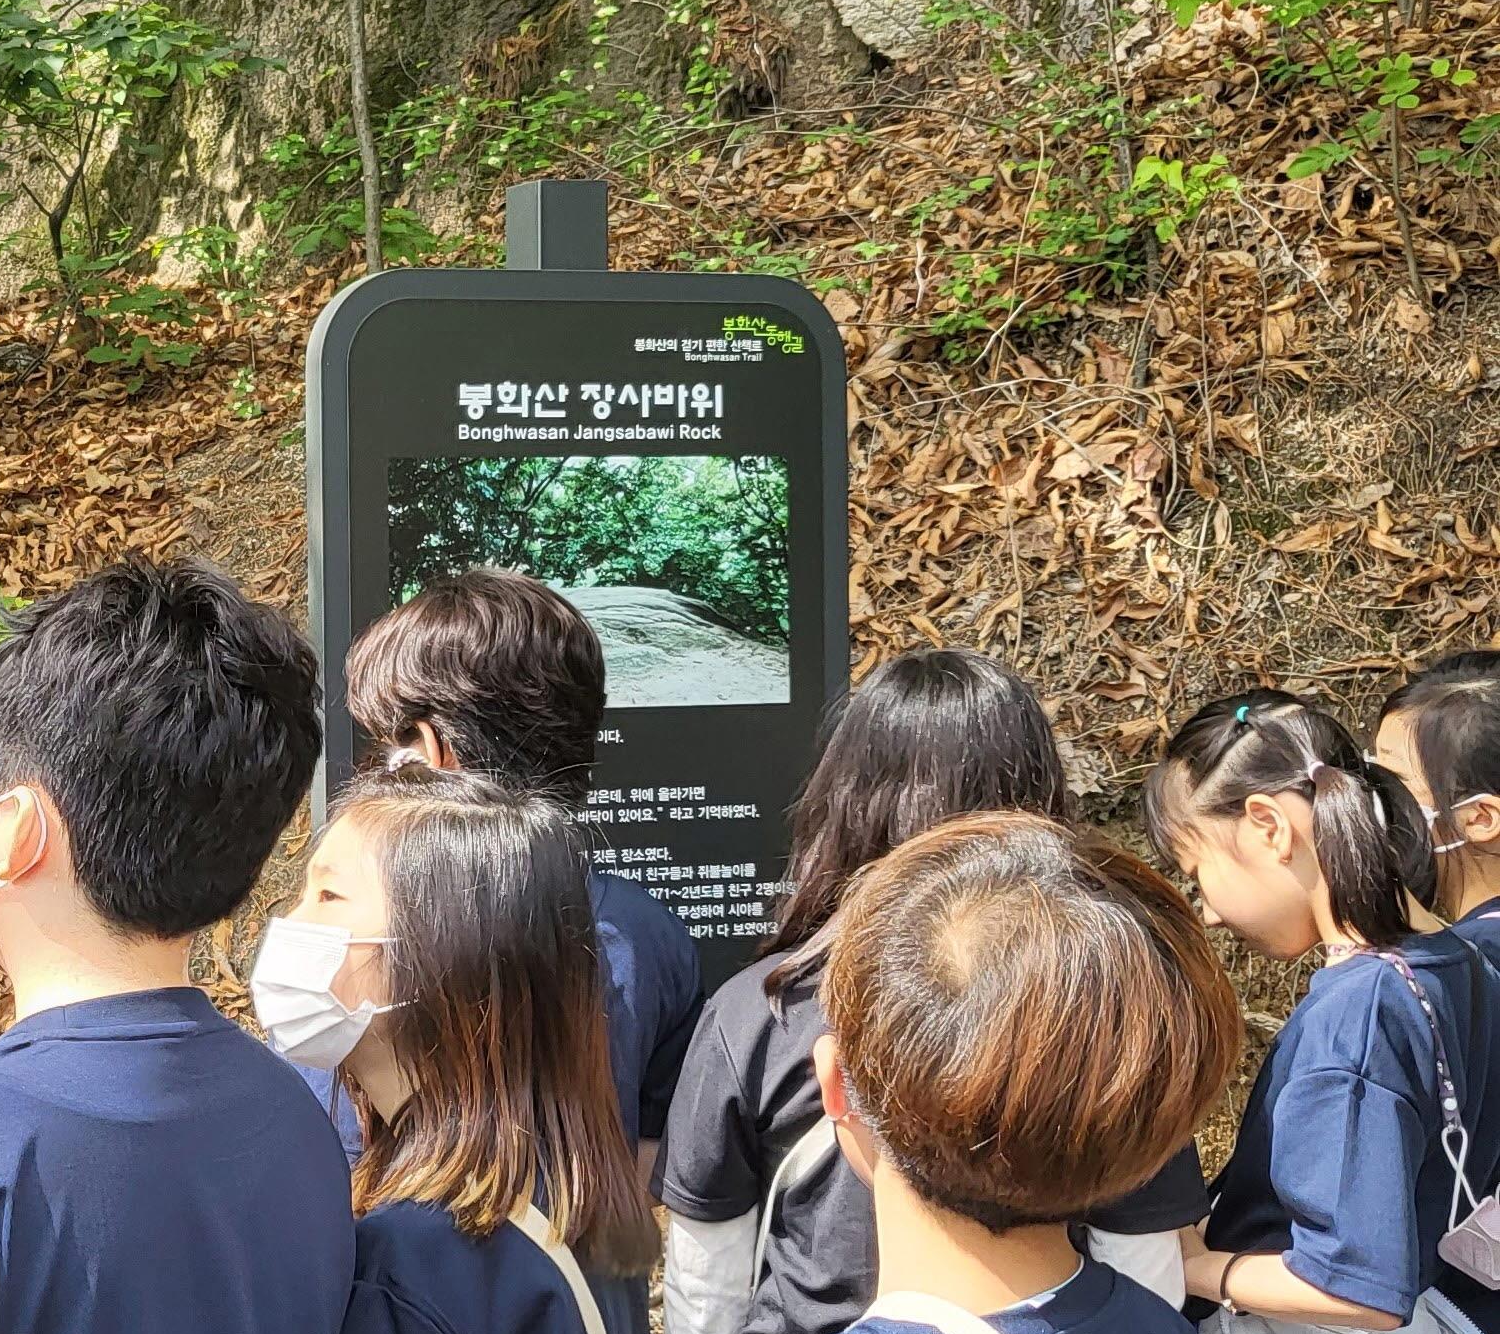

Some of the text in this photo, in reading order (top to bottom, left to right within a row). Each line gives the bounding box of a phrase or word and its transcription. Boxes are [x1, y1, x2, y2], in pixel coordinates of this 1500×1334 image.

[634, 339, 678, 352] 봉화산의
[681, 339, 703, 352] 걷기
[705, 339, 728, 352] 편한
[684, 353, 763, 363] Bonghwasan Trail
[458, 381, 724, 420] 봉화산 장사바위
[458, 424, 722, 442] Bonghwasan Jangsabawi Rock
[629, 788, 654, 803] 위에
[657, 786, 706, 802] 올라가면
[577, 809, 614, 825] 바닥이
[669, 807, 694, 821] 라고
[698, 804, 760, 820] 기억하였다.
[593, 849, 617, 864] 깃든
[621, 846, 674, 863] 장소였다.
[645, 866, 694, 882] 친구들과
[697, 863, 756, 879] 쥐불놀이를
[728, 883, 752, 897] 친구
[676, 904, 724, 920] 무성하여
[727, 902, 763, 917] 시야를
[685, 924, 713, 939] 네가
[716, 923, 729, 937] 다
